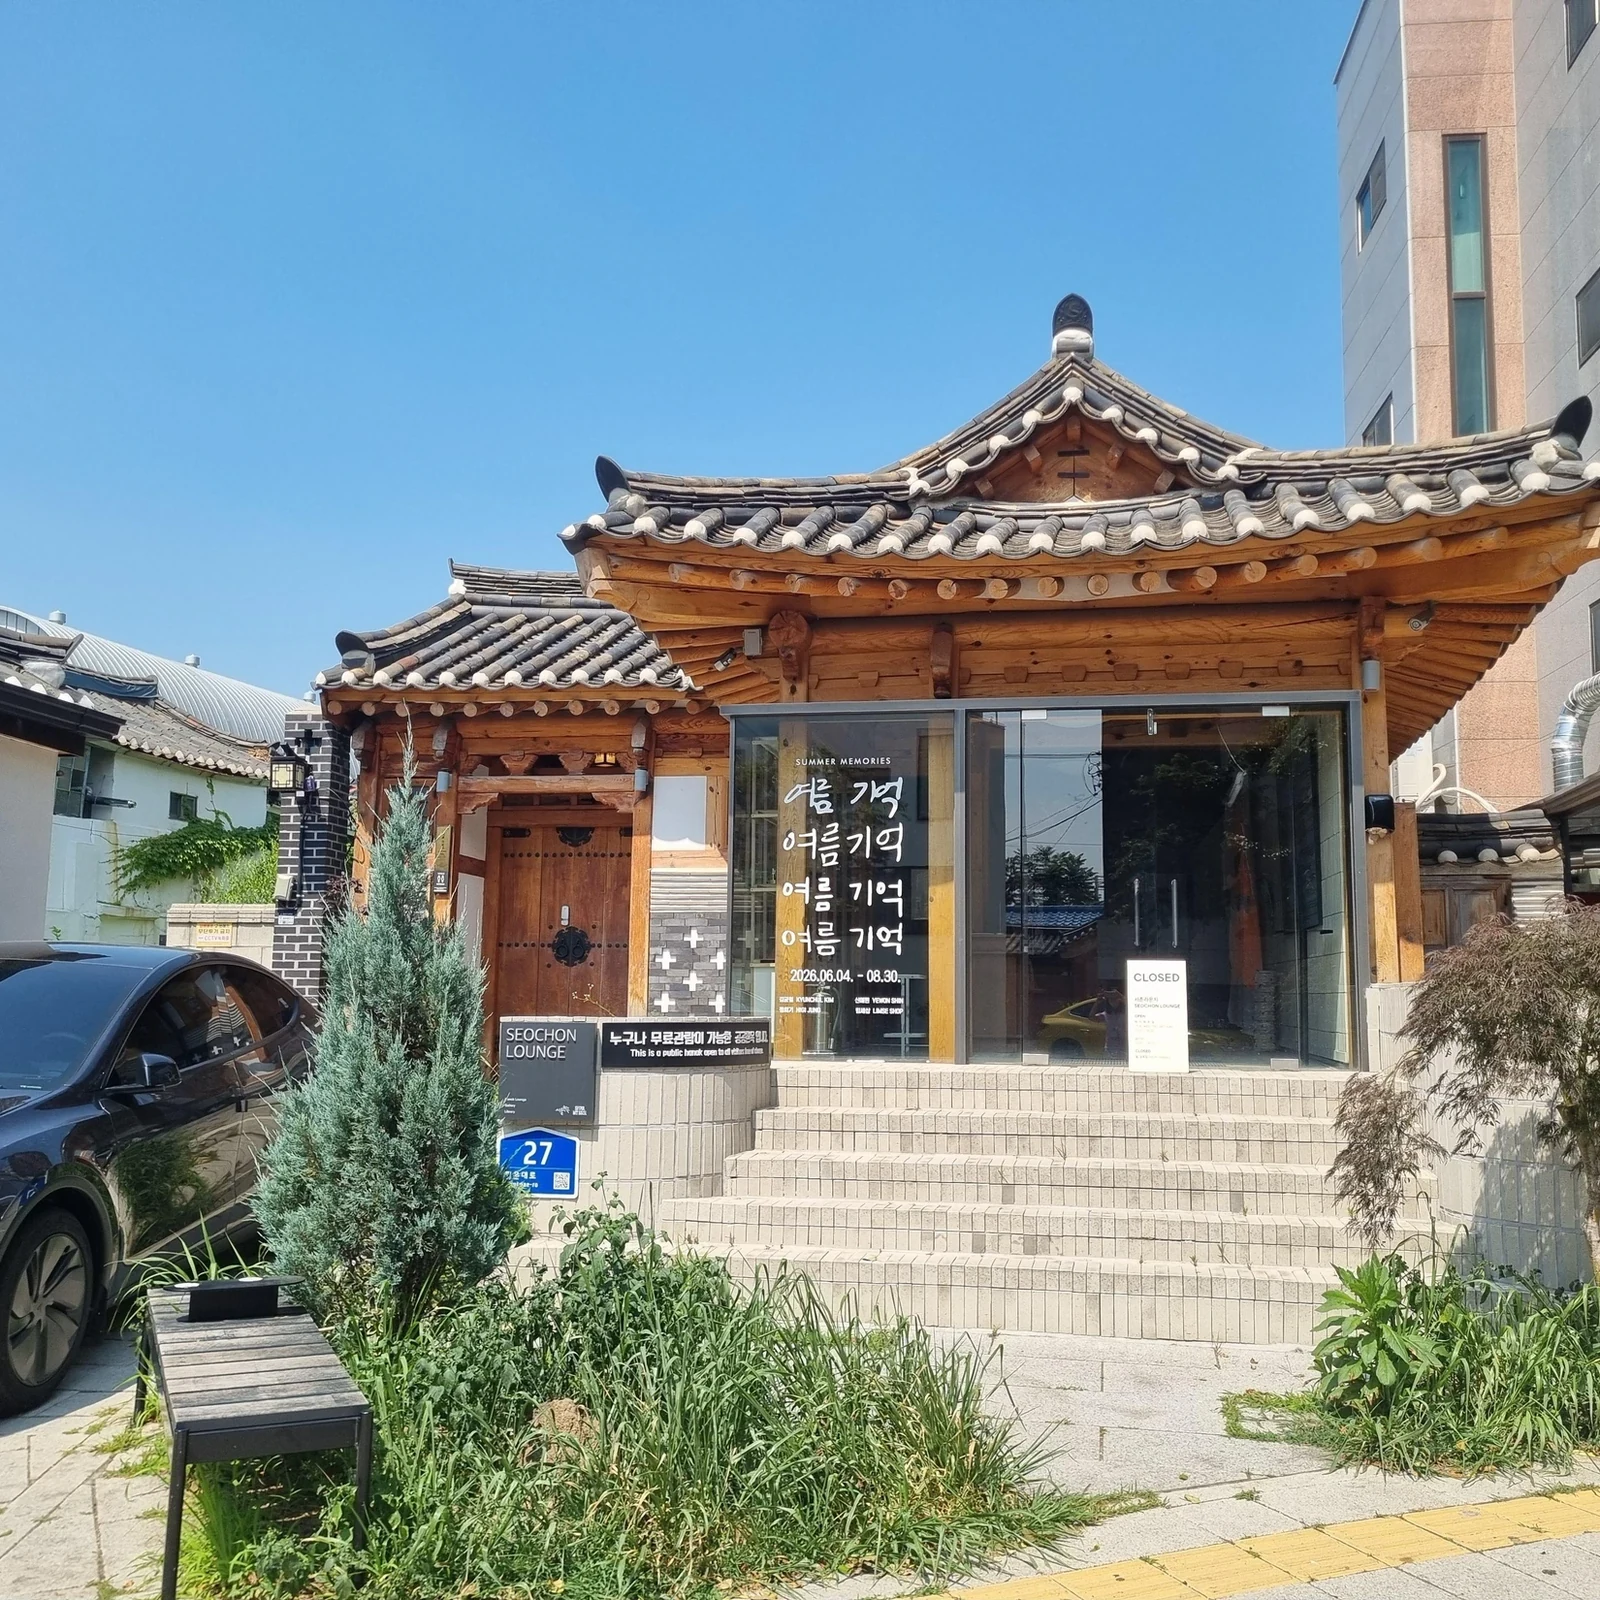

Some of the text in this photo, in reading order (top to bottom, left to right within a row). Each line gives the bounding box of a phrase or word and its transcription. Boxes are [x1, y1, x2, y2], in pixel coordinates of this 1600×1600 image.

[795, 757, 891, 766] SUMMER MEMORIES
[784, 776, 903, 819] 여름 기억
[783, 822, 903, 867] 여름 기억
[782, 876, 903, 918] 여름 기억
[781, 922, 903, 956] 여름 기억
[790, 969, 854, 983] 2026.06.04.
[866, 969, 901, 983] 08.30.
[1134, 973, 1180, 982] CLOSED
[506, 1027, 577, 1042] SEOCHON
[610, 1031, 648, 1046] 누구나
[650, 1031, 705, 1046] 무료관람이
[706, 1030, 732, 1045] 가능한
[506, 1045, 566, 1059] LOUNGE
[630, 1048, 647, 1057] This
[648, 1048, 655, 1057] is
[662, 1048, 683, 1057] public
[703, 1049, 718, 1057] open
[523, 1140, 553, 1165] 27
